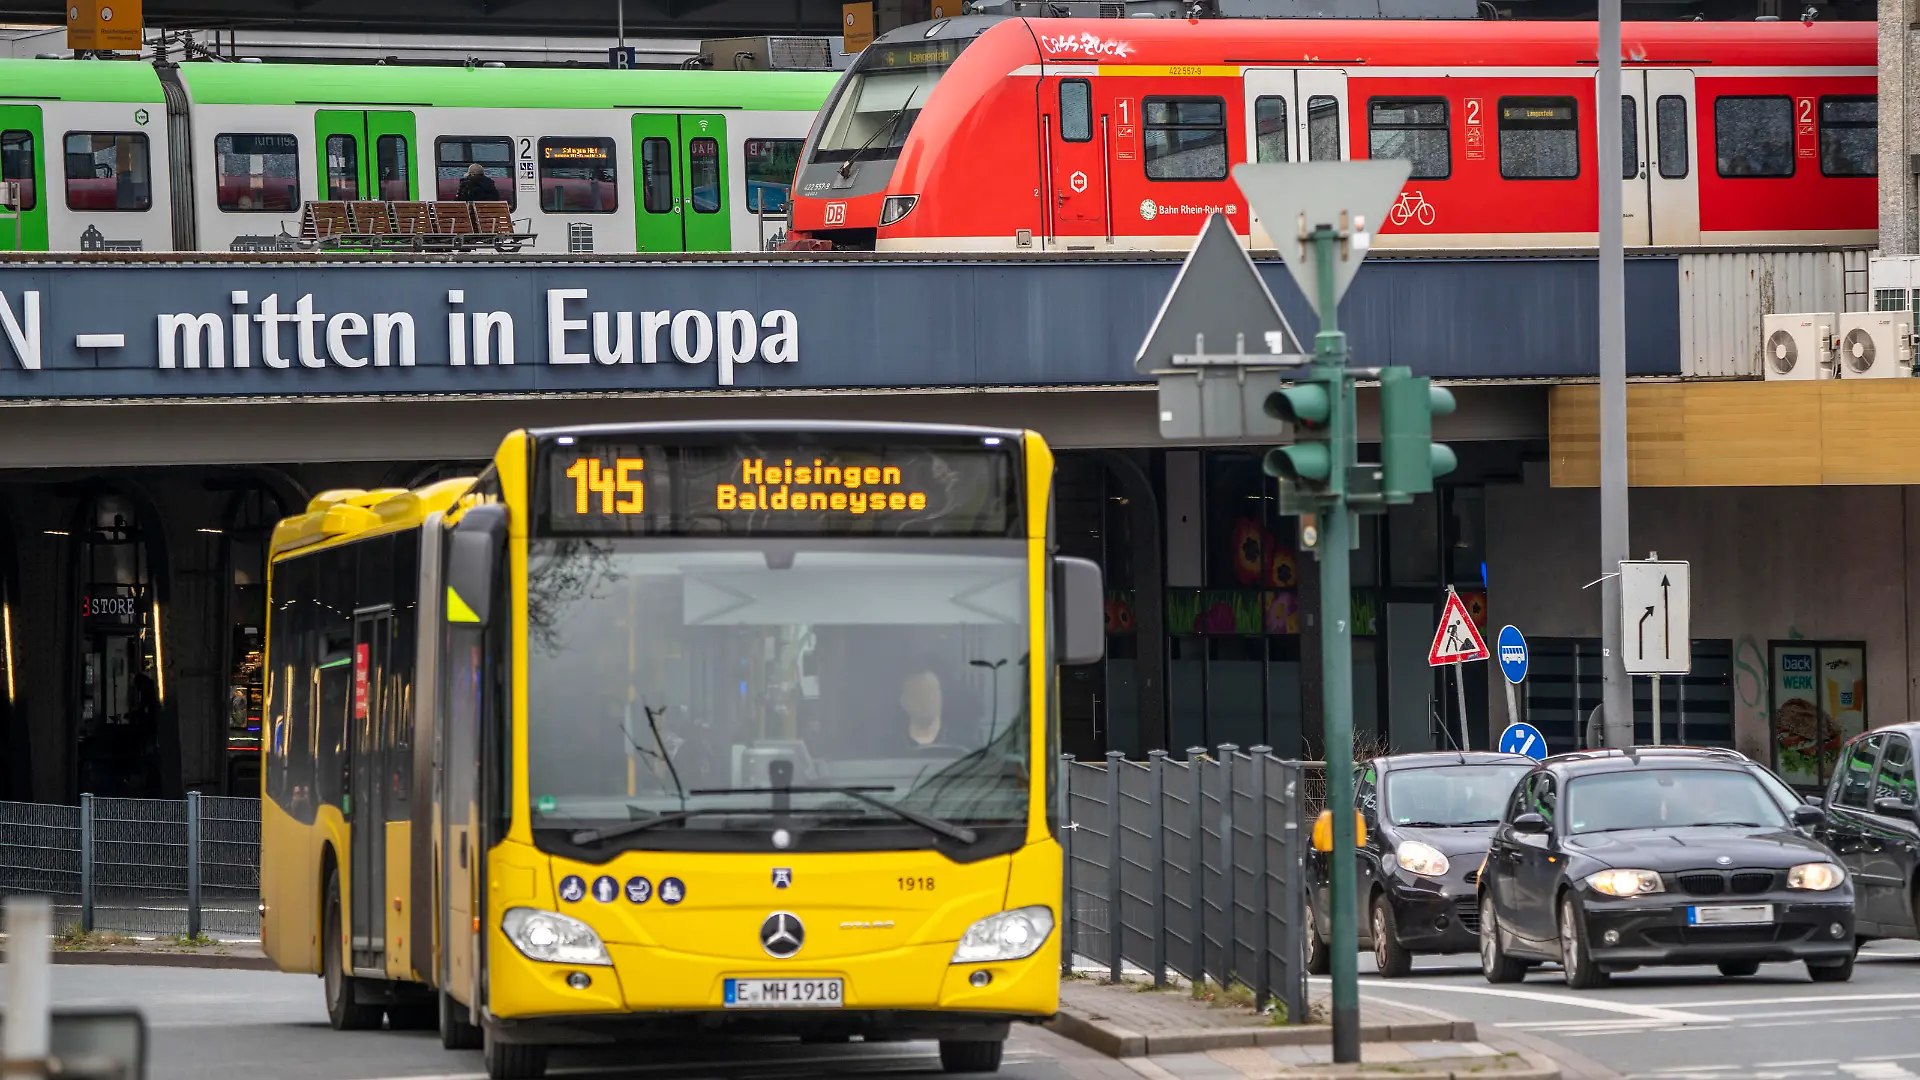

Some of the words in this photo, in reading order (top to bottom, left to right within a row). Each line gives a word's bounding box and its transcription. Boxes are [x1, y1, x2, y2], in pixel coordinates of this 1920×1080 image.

[909, 48, 949, 64] Langenfeld
[1169, 67, 1182, 75] 422
[1183, 67, 1202, 75] 557-9
[1119, 99, 1128, 124] 1
[1467, 100, 1480, 124] 2
[1800, 99, 1812, 123] 2
[520, 138, 532, 159] 2
[1034, 189, 1039, 197] 2
[827, 205, 843, 222] DB
[1159, 205, 1179, 214] Bahn
[1180, 204, 1223, 214] Rhein-Ruhr
[158, 290, 416, 368] mitten
[448, 289, 514, 366] in
[547, 288, 799, 386] Europa
[566, 458, 644, 514] 145
[743, 458, 900, 488] Heisingen
[716, 484, 926, 514] Baldeneysee
[1603, 648, 1610, 657] 12
[1784, 656, 1811, 670] back
[1783, 675, 1813, 690] WERK
[898, 877, 935, 891] 1918
[792, 983, 839, 1000] 1918
